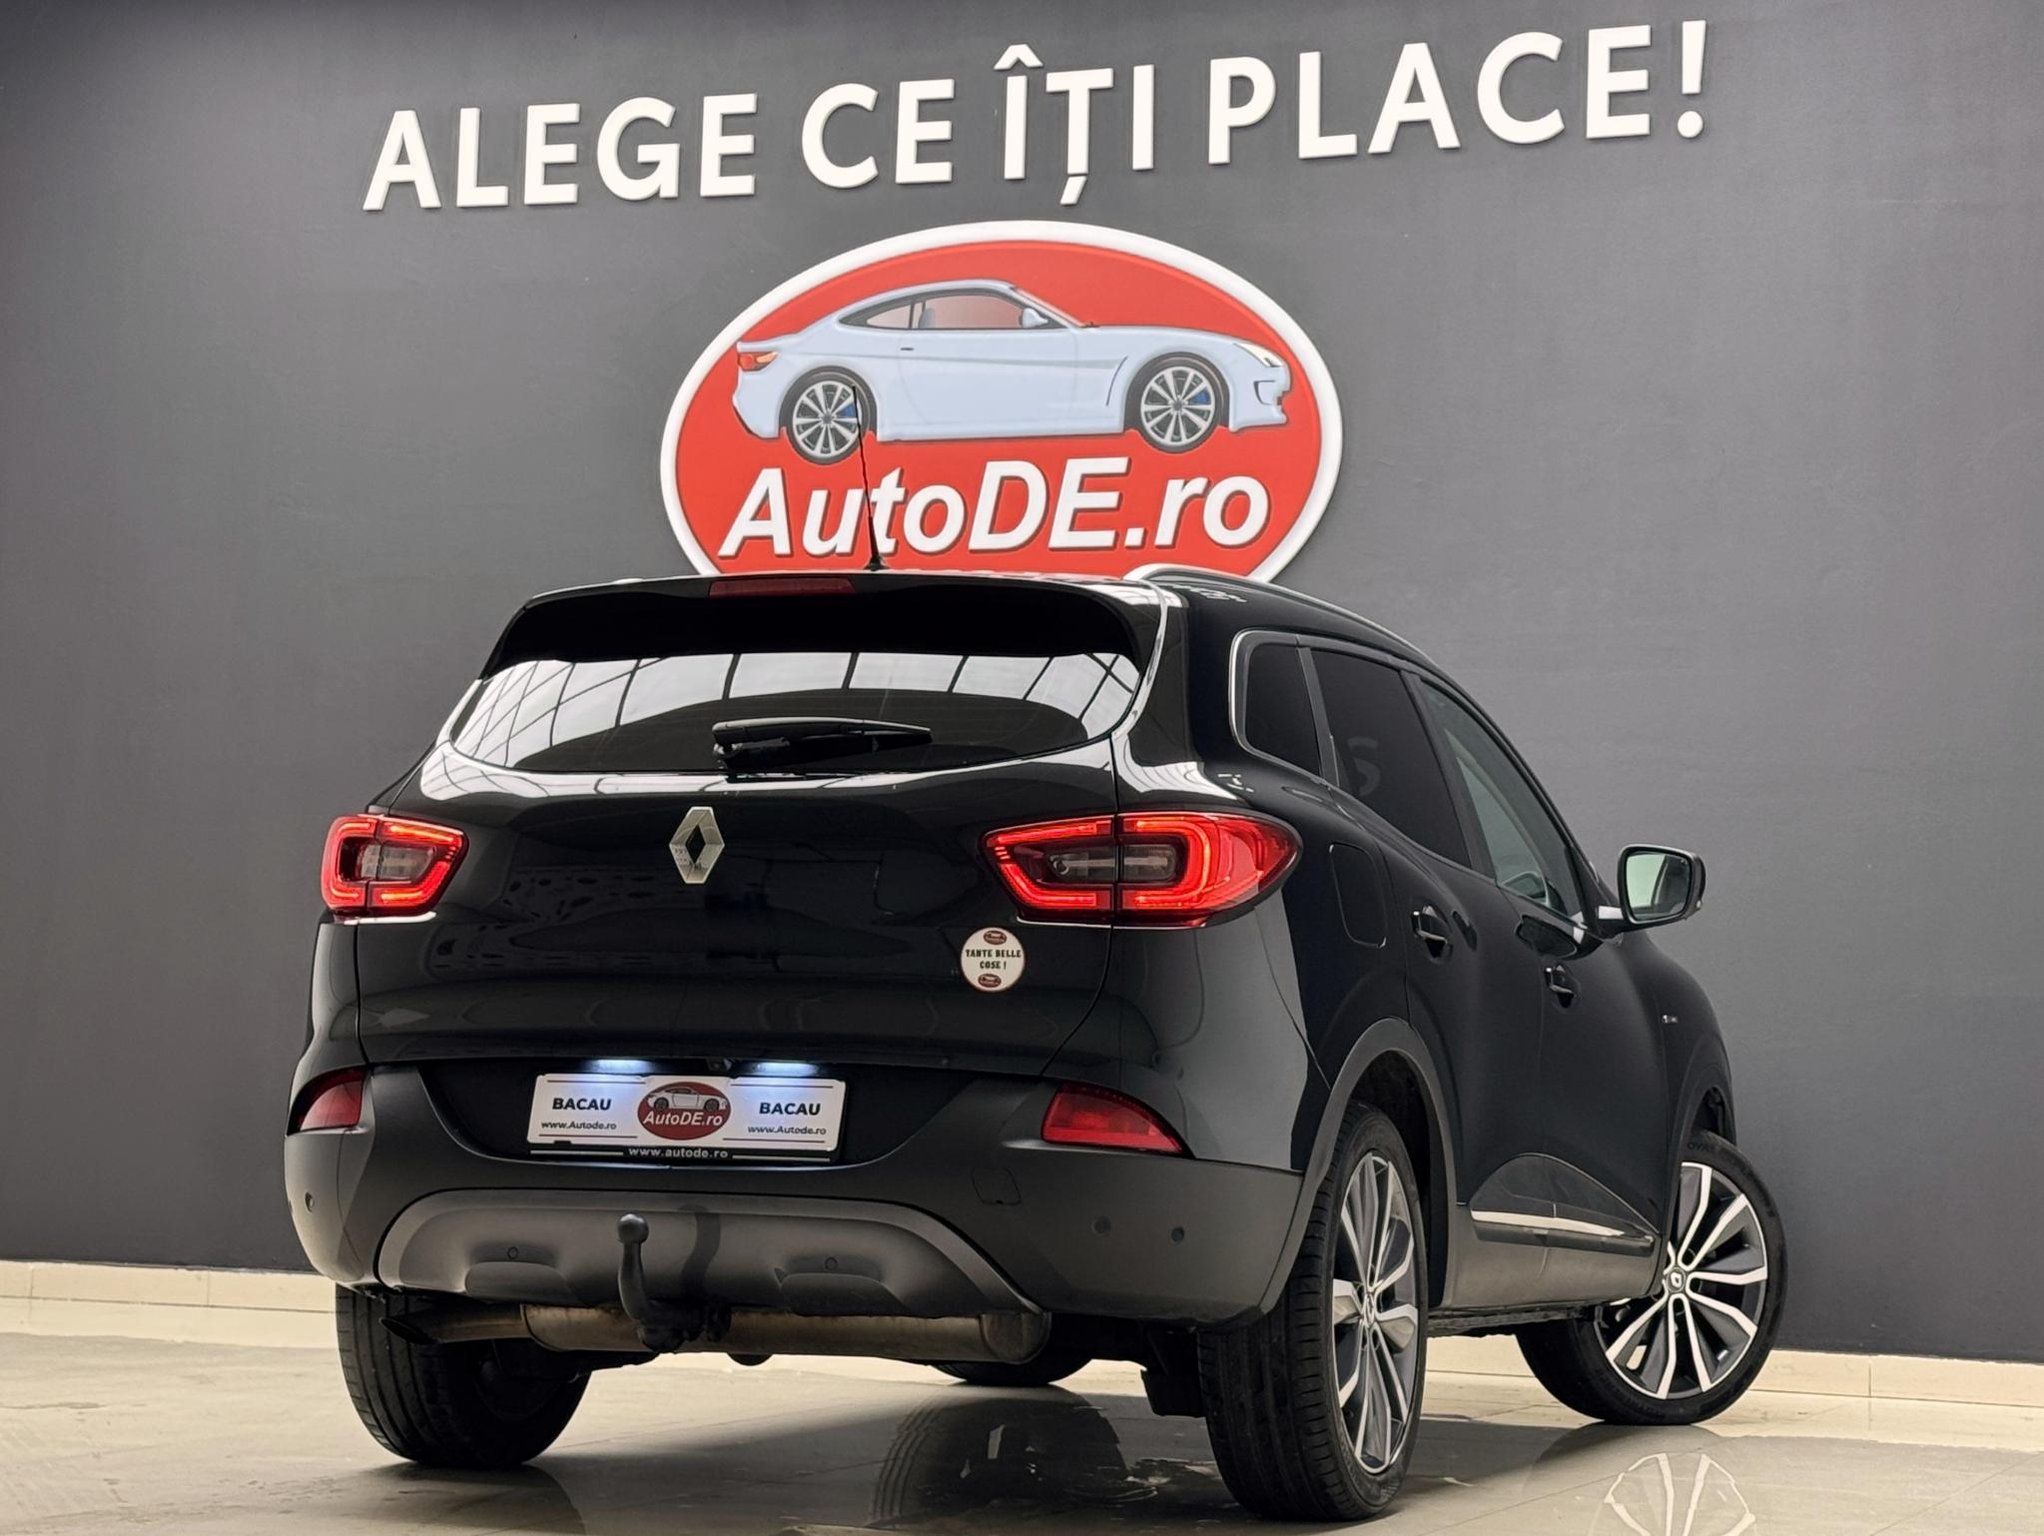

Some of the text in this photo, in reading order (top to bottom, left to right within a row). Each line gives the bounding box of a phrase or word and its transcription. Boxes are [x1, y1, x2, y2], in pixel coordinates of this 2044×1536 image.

[363, 94, 757, 211] ALEGE
[801, 79, 955, 188] CE
[1208, 20, 1706, 165] PLACE!
[718, 455, 1269, 557] AutoDE.ro
[965, 949, 1021, 958] TANTE BELLE
[552, 1098, 611, 1111] BACAU
[759, 1102, 821, 1116] BACAU
[541, 1120, 617, 1131] www.Autode.ro
[643, 1112, 723, 1128] AutoDE.ro
[747, 1125, 827, 1136] www.Autode.ro
[628, 1147, 729, 1159] www.autode.ro
